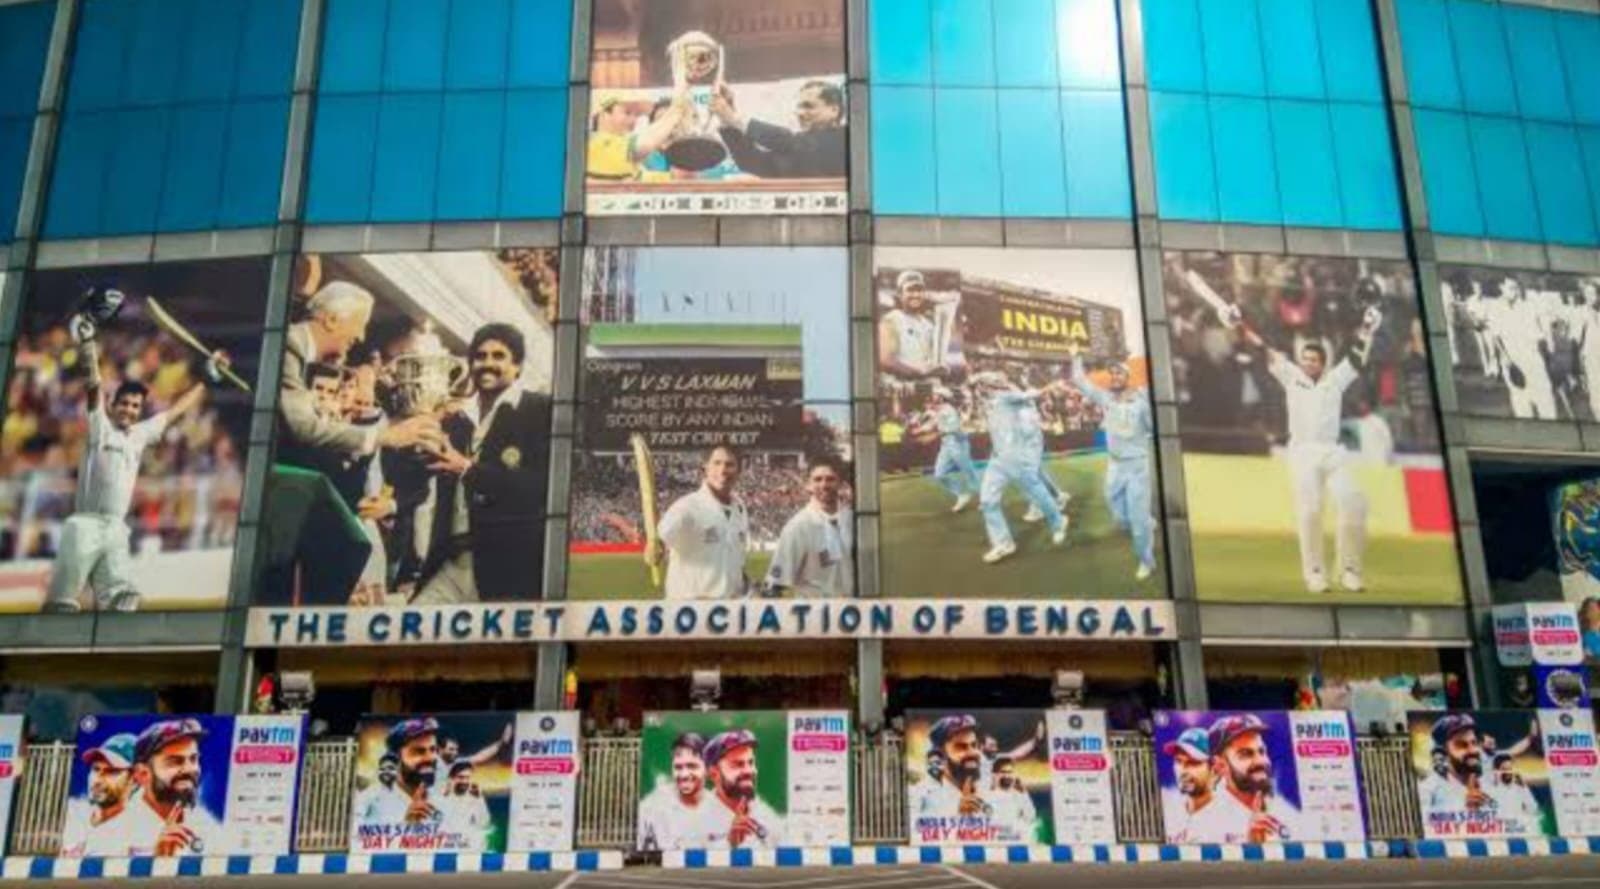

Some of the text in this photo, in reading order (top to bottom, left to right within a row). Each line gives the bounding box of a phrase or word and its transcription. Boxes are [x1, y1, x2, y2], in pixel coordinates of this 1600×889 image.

[1003, 309, 1089, 340] INDIA
[621, 374, 756, 390] V V S LAXMAN
[661, 414, 682, 426] BY
[651, 432, 689, 445] TEST
[269, 604, 1165, 642] THE CRICKET ASSOCIATION OF BENGAL
